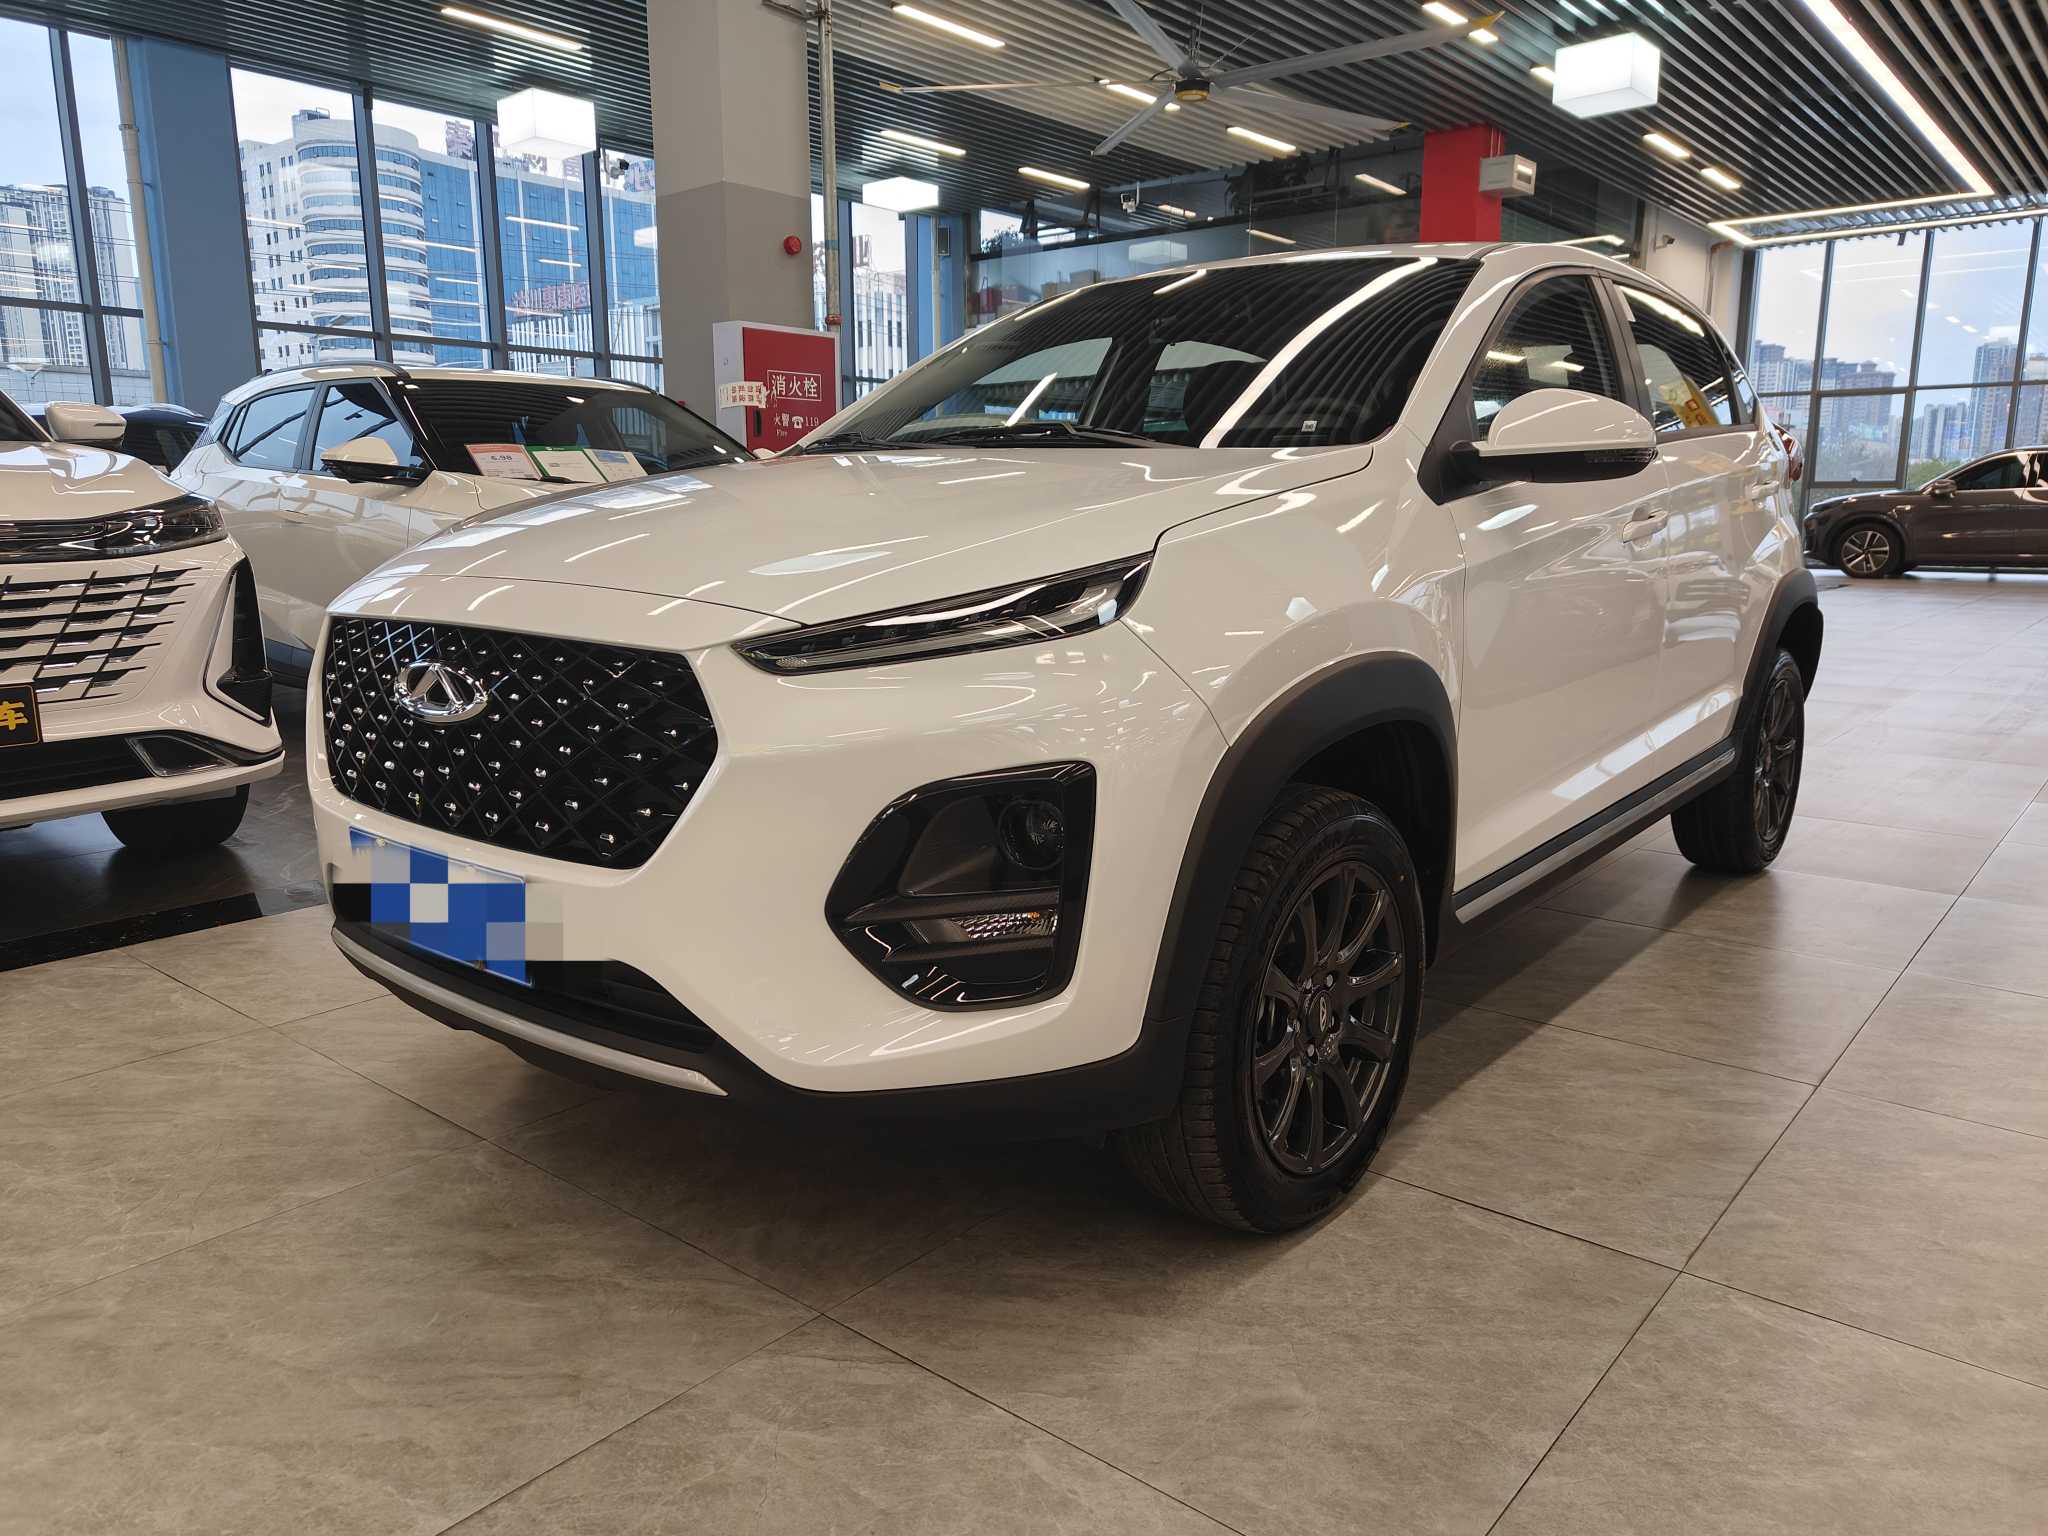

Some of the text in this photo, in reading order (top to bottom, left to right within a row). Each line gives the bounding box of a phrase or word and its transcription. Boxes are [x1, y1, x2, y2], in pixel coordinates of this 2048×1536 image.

[771, 374, 818, 398] 消火栓
[773, 412, 819, 427] 火警 119
[0, 701, 28, 730] 车
